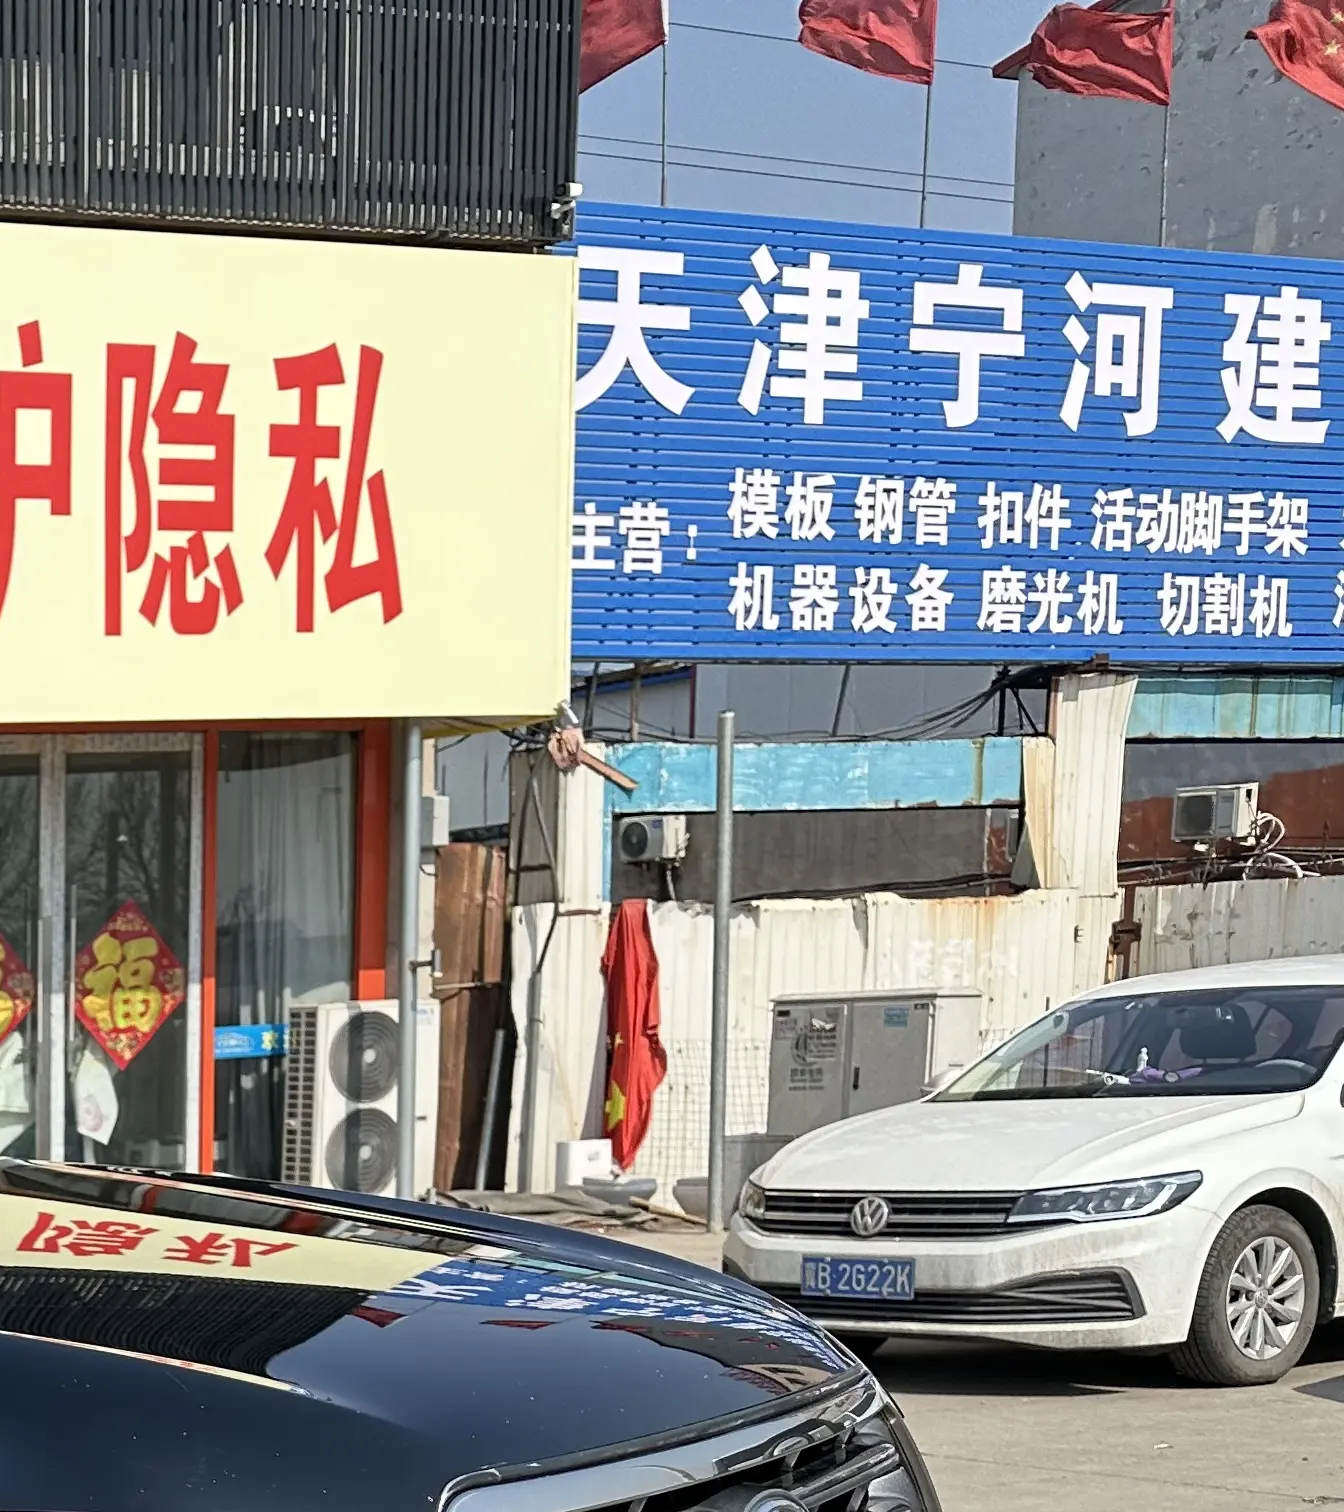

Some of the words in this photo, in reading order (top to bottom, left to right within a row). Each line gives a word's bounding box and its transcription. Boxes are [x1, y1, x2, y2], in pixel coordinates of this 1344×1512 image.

[576, 244, 1332, 444] 天津宁河建
[728, 467, 836, 543] 模板
[854, 475, 958, 547] 钢管
[977, 482, 1072, 552] 扣件
[1090, 488, 1310, 558] 活动脚手架
[728, 562, 955, 633] 机器设备
[977, 567, 1124, 636] 磨光机
[1156, 572, 1293, 639] 切割机
[83, 932, 163, 1032] 福
